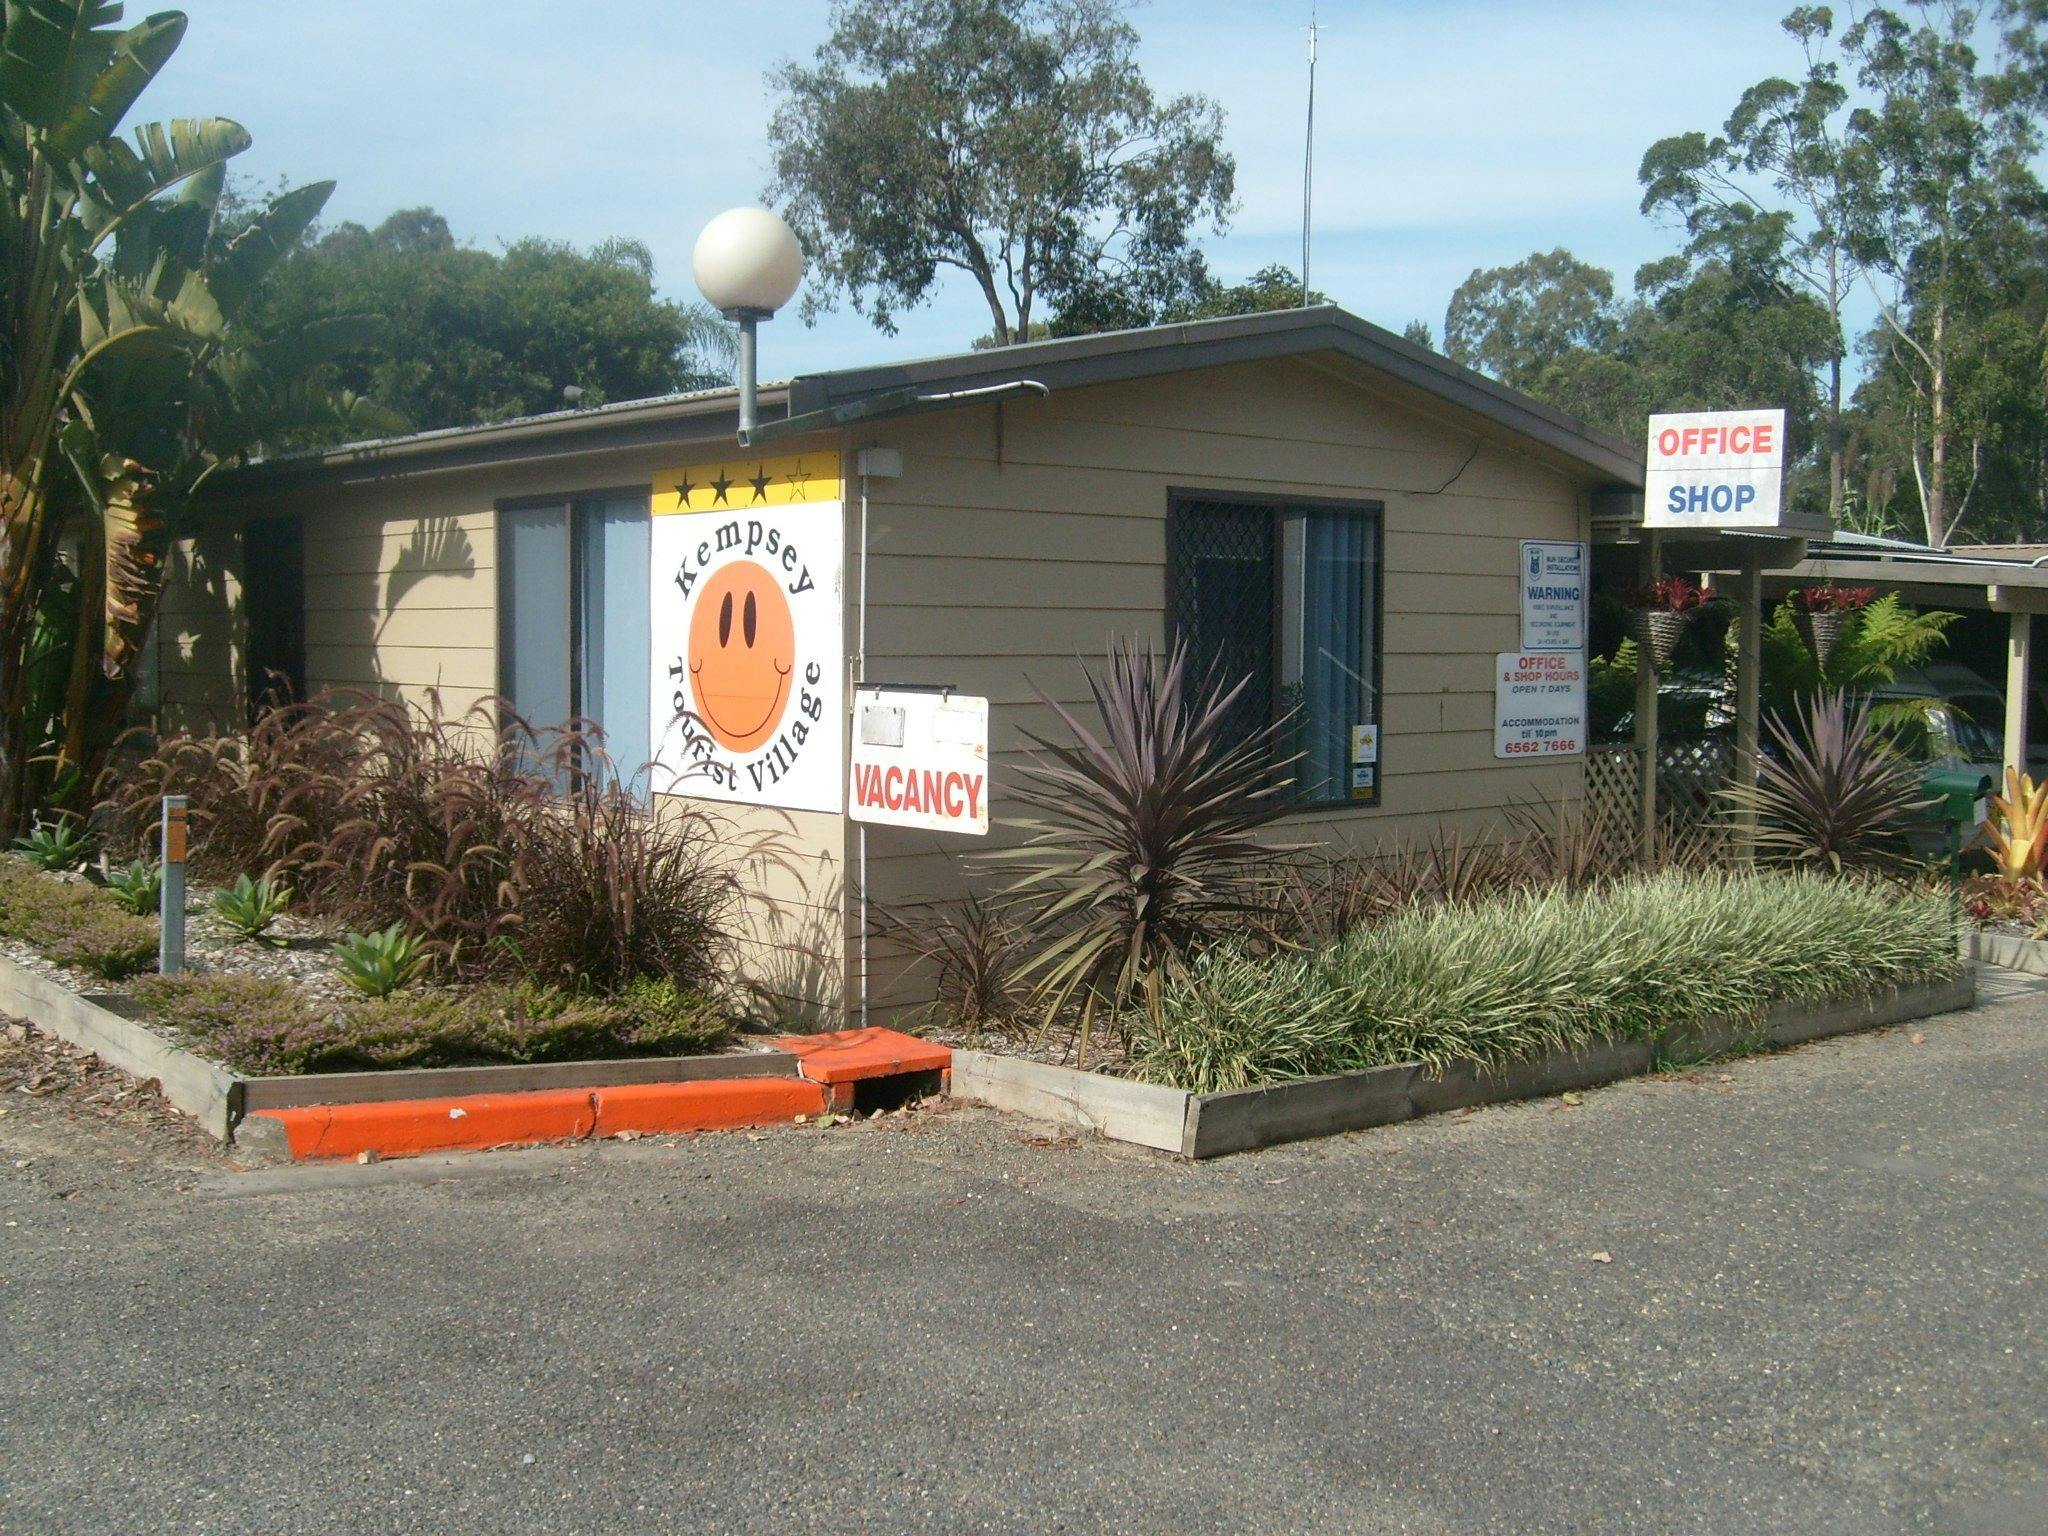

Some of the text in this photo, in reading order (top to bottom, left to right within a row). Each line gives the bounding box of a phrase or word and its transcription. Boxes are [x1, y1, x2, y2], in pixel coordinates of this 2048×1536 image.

[1658, 424, 1773, 457] OFFICE
[1667, 484, 1756, 514] SHOP
[674, 520, 815, 601] Kempsey
[1527, 586, 1580, 601] WARNING
[1519, 657, 1566, 670] OFFICE
[1503, 671, 1580, 682] & SHOP HOURS
[1512, 684, 1571, 694] OPEN 7 DAYS
[669, 656, 822, 792] Tourist Village
[1502, 717, 1580, 728] ACCOMMODATION
[1505, 740, 1576, 754] 6562 7666
[855, 763, 984, 819] VACANCY
